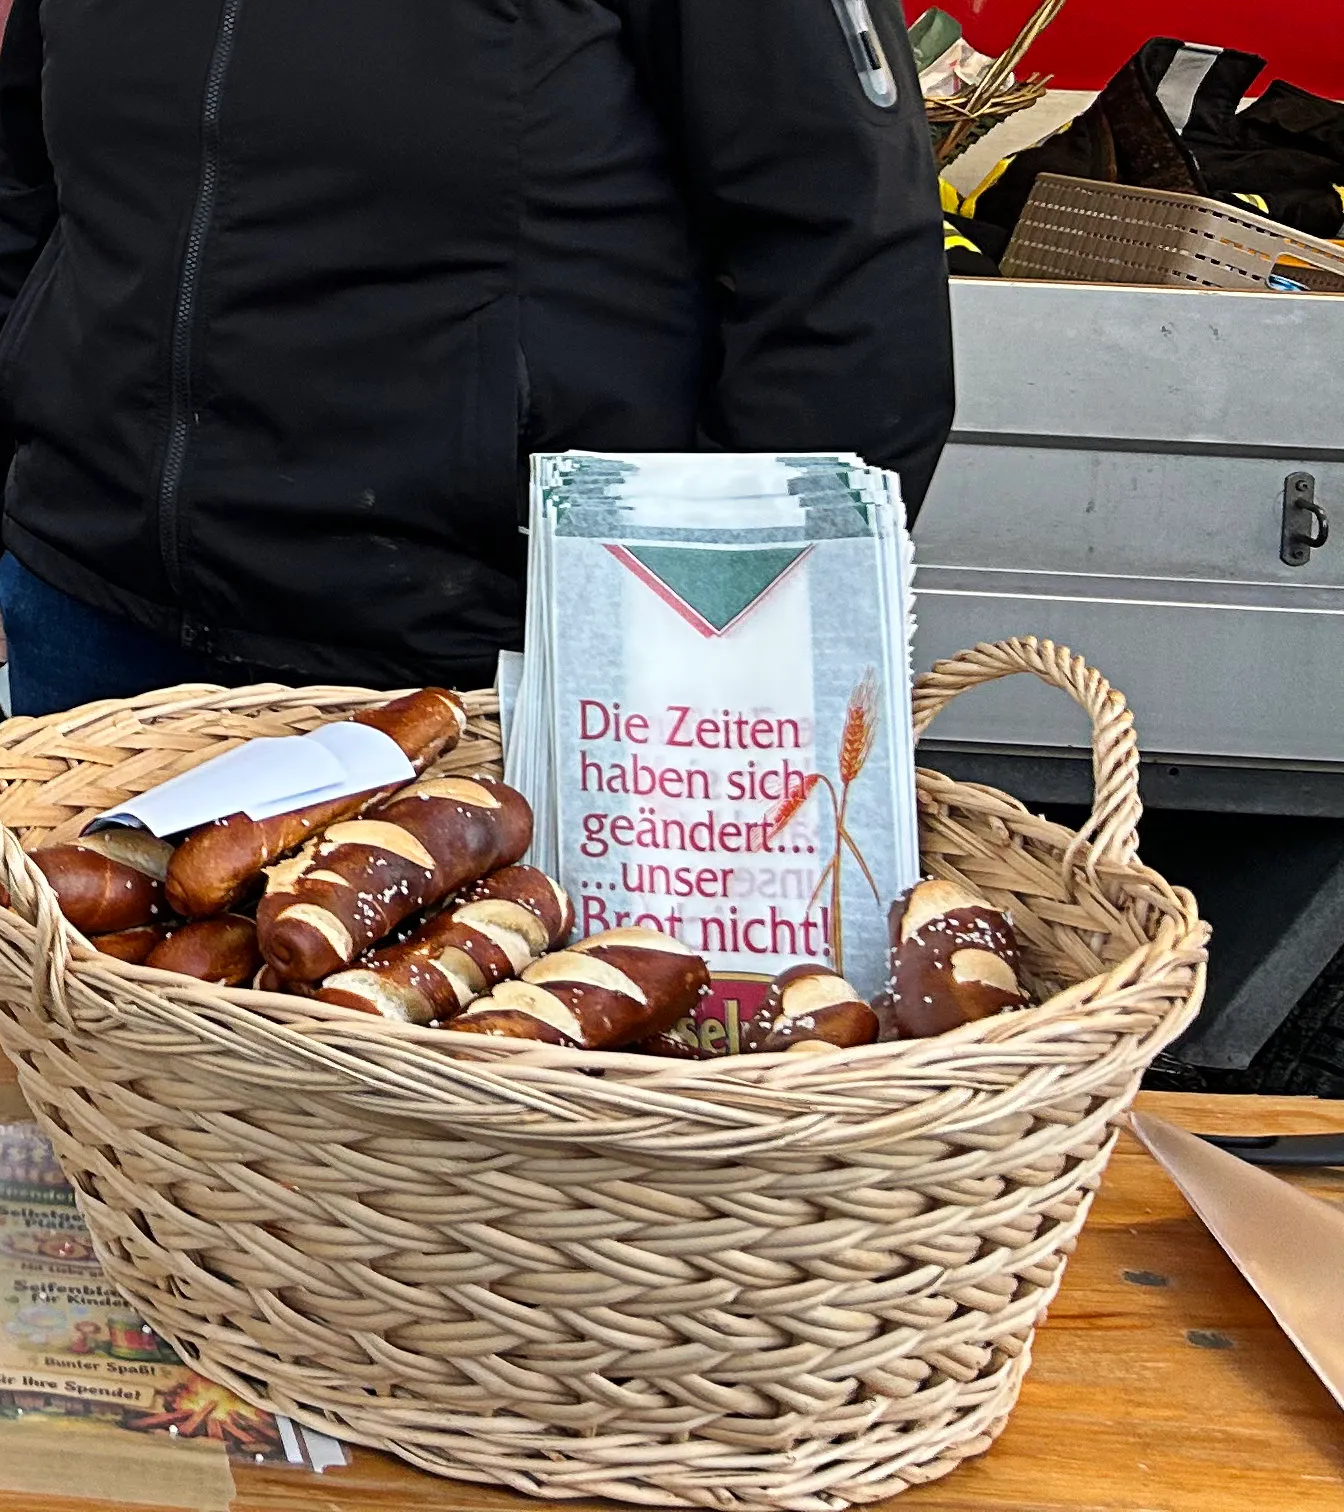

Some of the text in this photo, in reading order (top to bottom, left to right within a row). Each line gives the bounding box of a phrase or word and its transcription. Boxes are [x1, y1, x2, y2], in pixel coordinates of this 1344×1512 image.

[579, 699, 801, 749] Die Zeiten
[580, 750, 808, 801] haben sich
[580, 806, 815, 857] geändert...
[581, 862, 734, 898] ...unser
[701, 905, 832, 957] nicht!
[22, 1375, 57, 1390] Ihre
[64, 1379, 142, 1402] Spende!
[44, 1356, 101, 1371] Bunter
